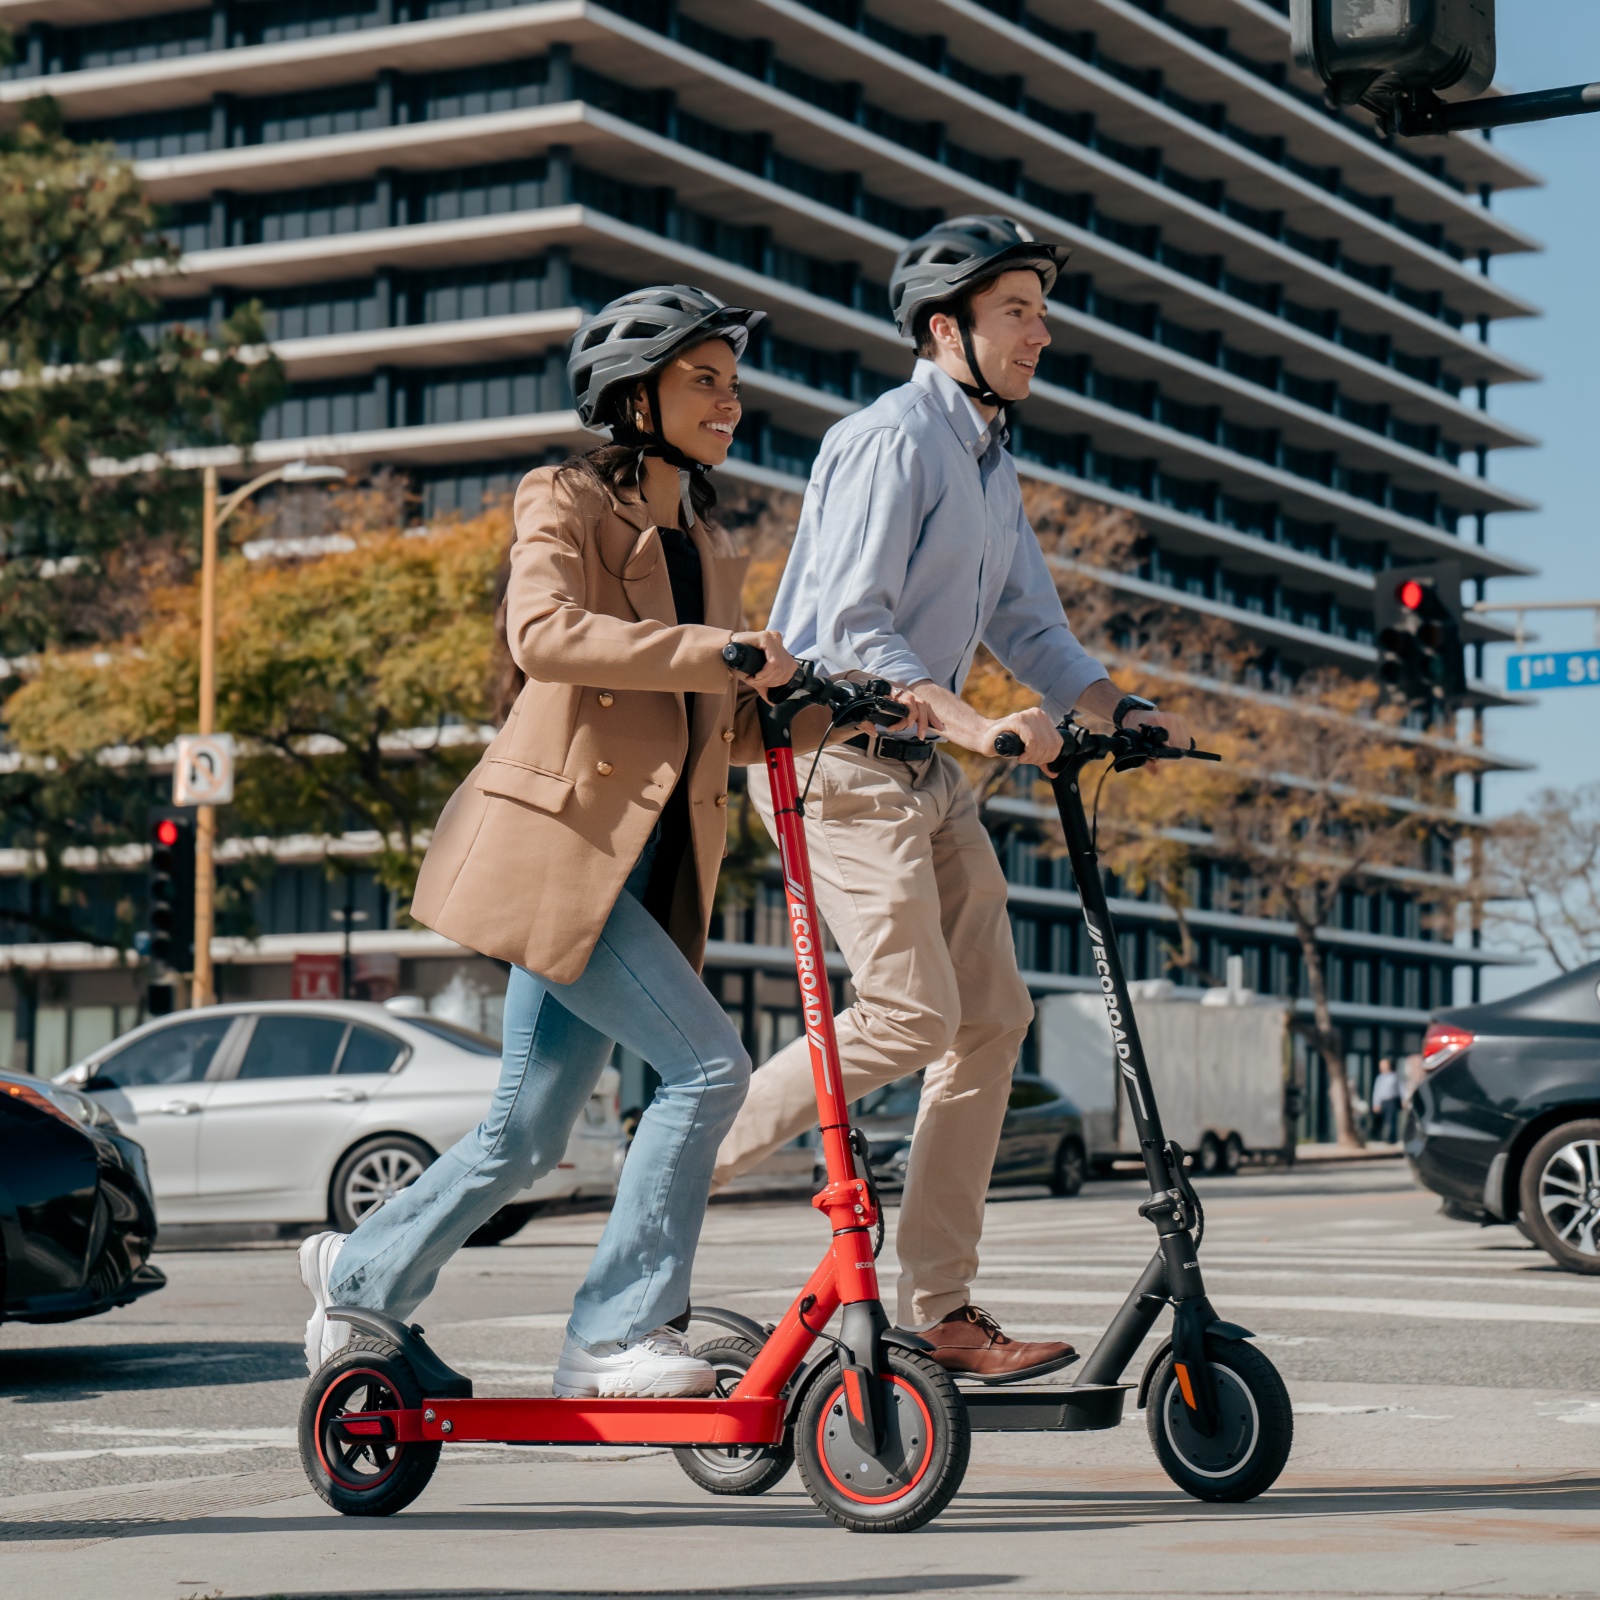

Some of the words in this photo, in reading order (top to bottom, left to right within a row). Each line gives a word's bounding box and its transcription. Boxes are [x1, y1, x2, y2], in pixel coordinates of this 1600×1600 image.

[1519, 656, 1556, 688] 1st
[1567, 655, 1600, 683] St
[790, 903, 822, 1027] ECOROAD
[1092, 946, 1130, 1060] ECOROAD
[606, 1377, 633, 1388] FILA
